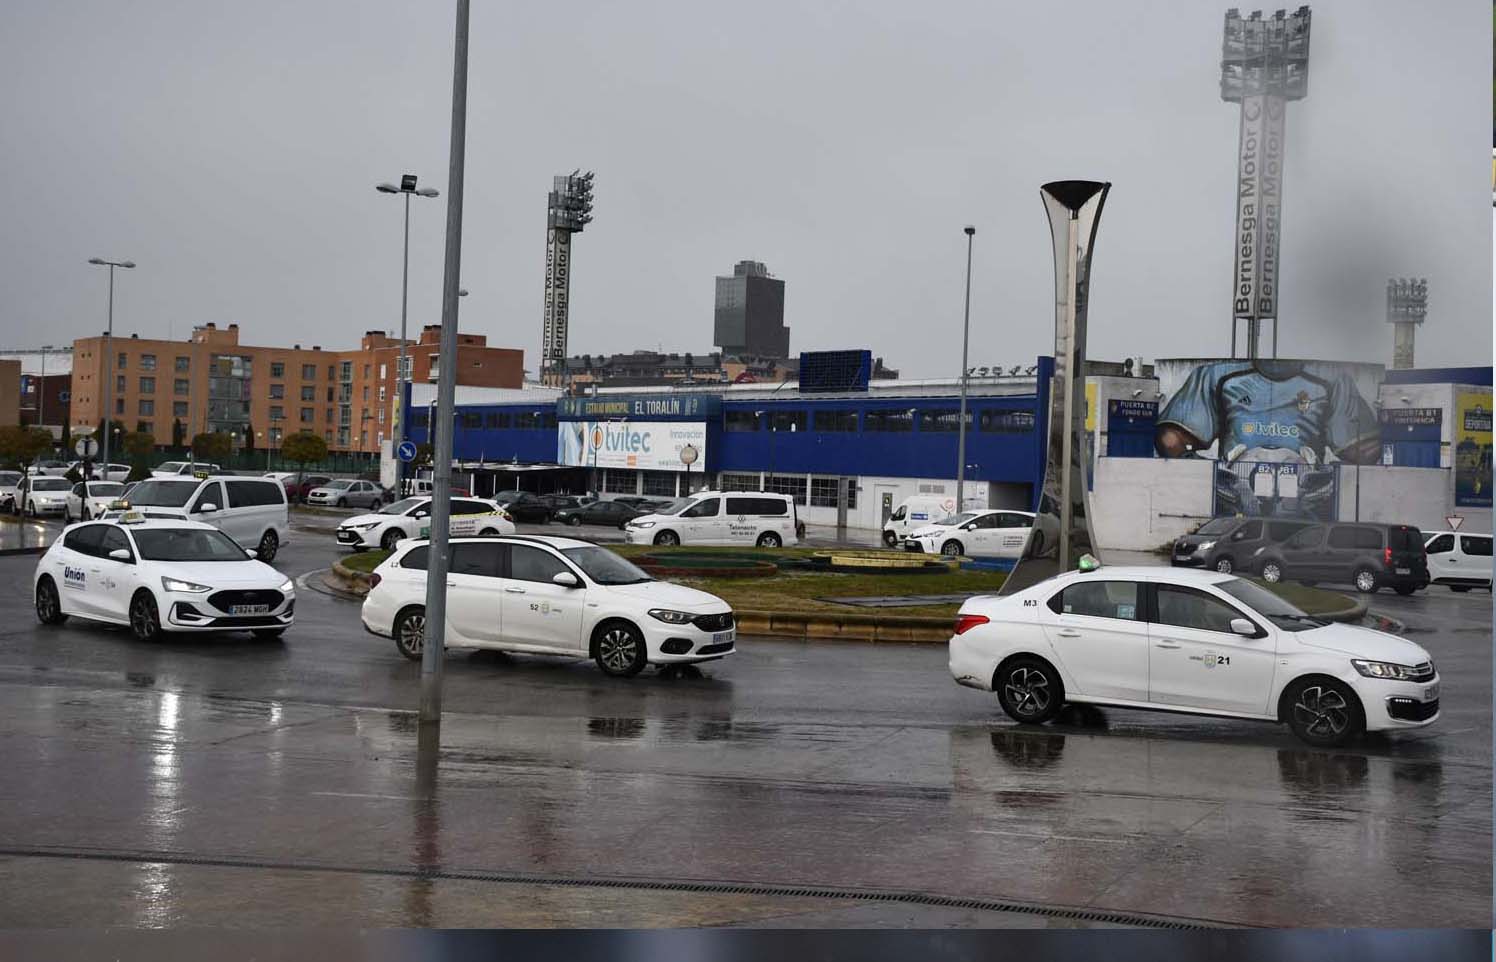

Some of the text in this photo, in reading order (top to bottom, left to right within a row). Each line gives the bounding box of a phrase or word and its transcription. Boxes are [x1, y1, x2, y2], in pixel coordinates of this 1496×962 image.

[1240, 131, 1257, 198] Motor
[1262, 131, 1280, 198] Motor
[557, 249, 568, 289] Motor
[1236, 203, 1257, 315] Bernesga
[1259, 204, 1281, 314] Bernesga
[554, 293, 568, 358] Bernesga
[635, 402, 646, 415] EL
[647, 398, 680, 415] TORALÍN
[606, 425, 651, 452] tvitec
[1258, 465, 1270, 474] B2
[64, 566, 86, 582] Unión
[1217, 656, 1231, 665] 21
